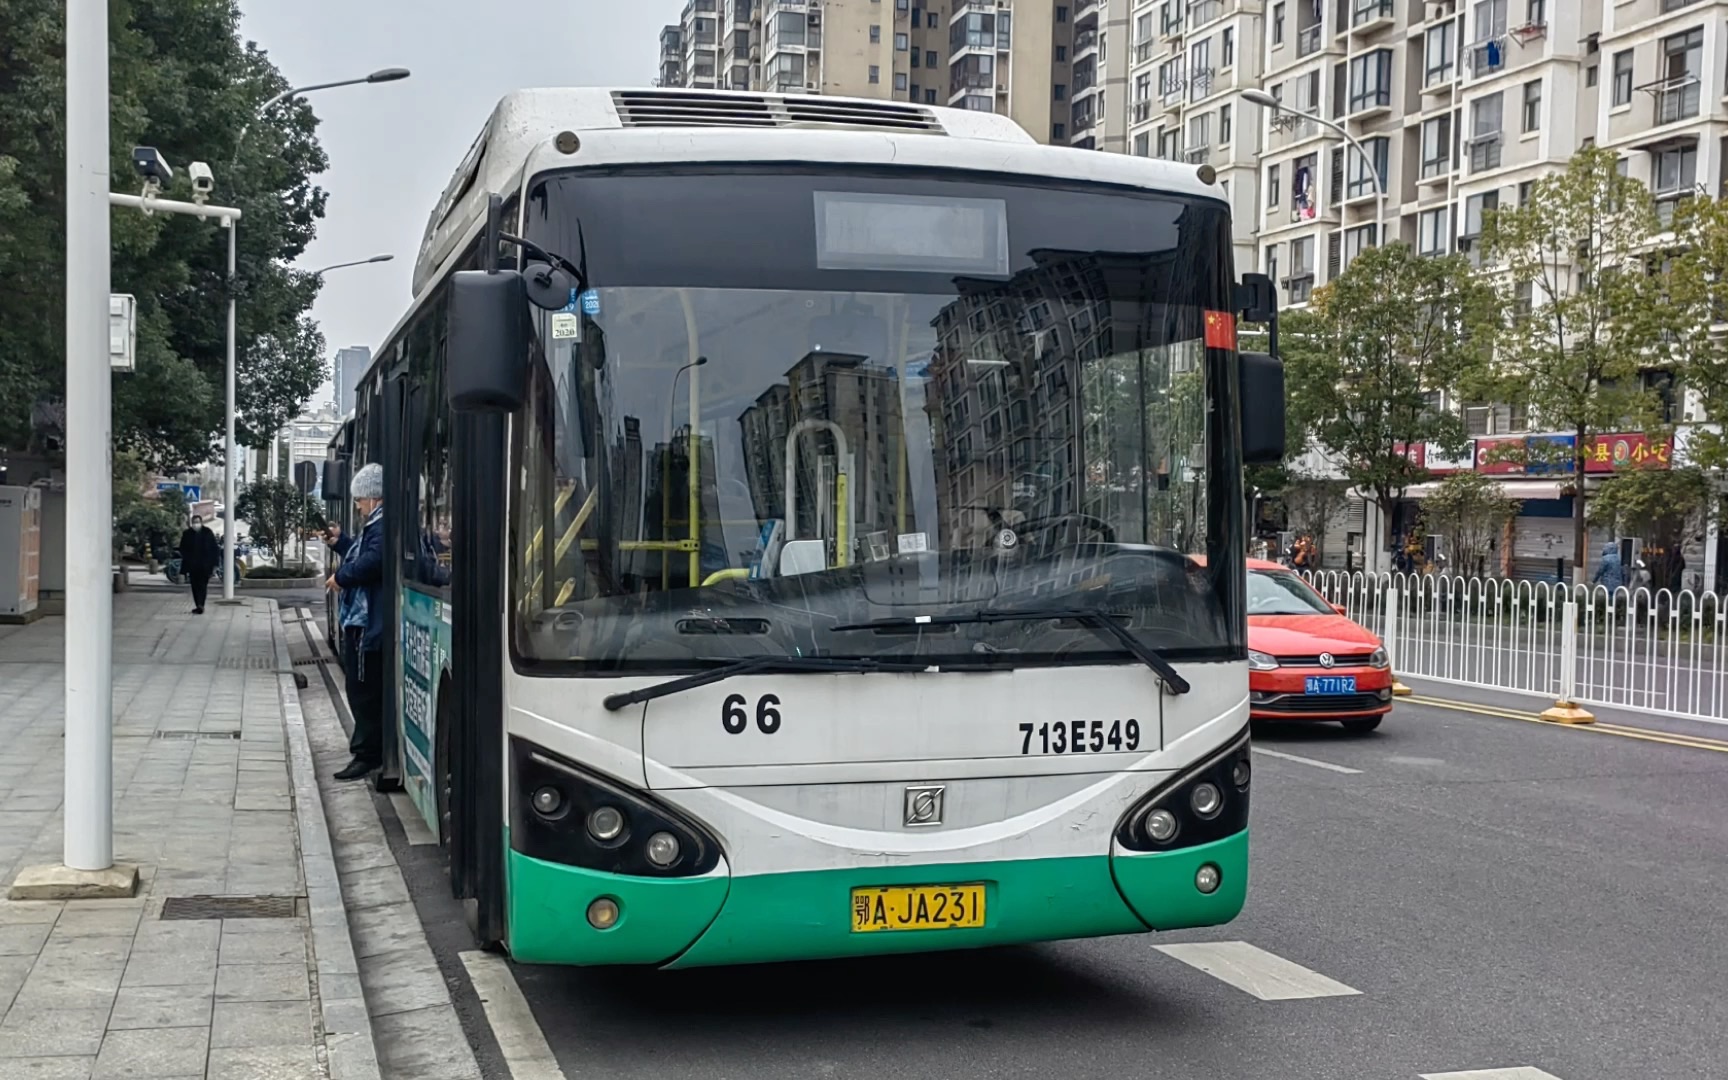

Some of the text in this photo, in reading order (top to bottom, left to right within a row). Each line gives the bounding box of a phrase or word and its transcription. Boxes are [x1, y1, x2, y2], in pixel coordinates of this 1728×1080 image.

[555, 328, 575, 337] 2020
[722, 693, 781, 734] 66
[1019, 719, 1140, 754] 713E549
